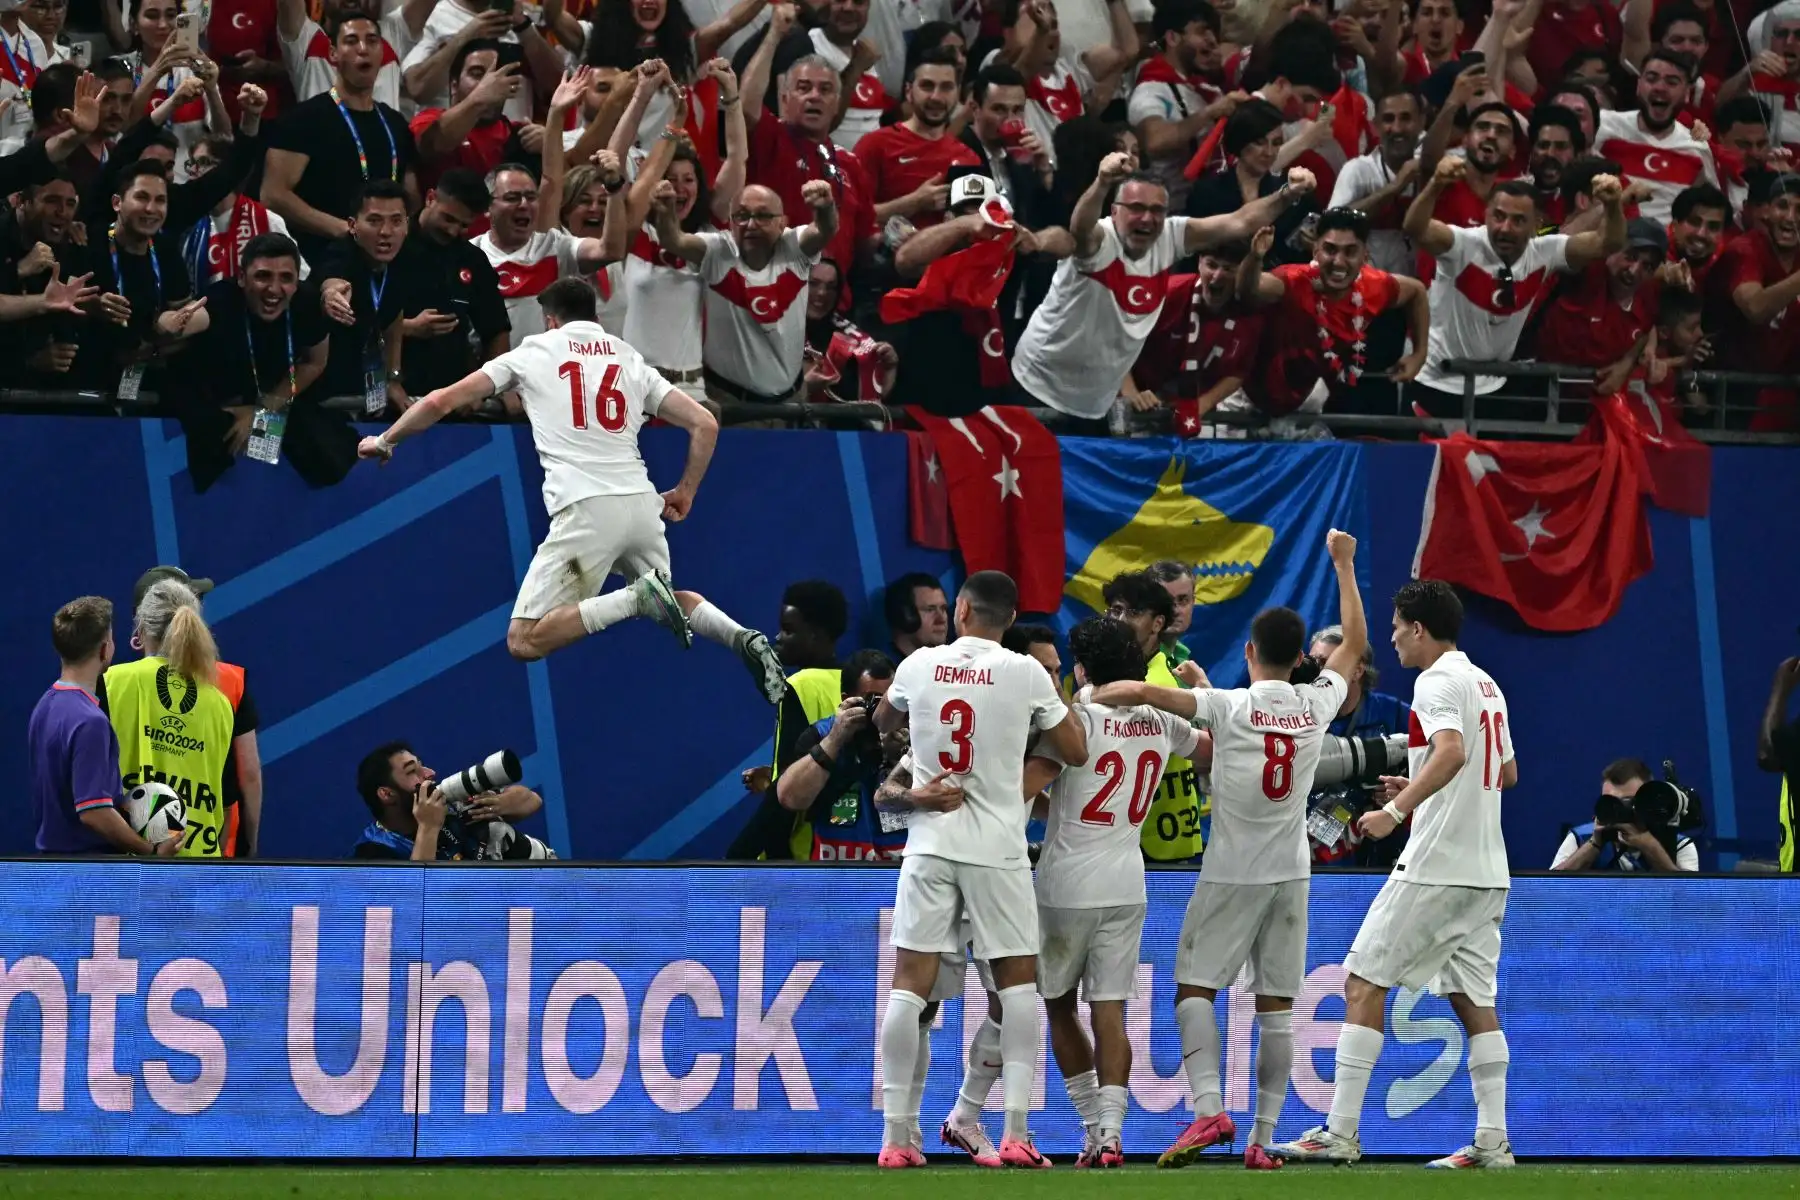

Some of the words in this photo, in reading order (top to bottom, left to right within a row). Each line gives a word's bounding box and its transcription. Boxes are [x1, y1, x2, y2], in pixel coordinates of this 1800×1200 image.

[558, 360, 628, 434] 16
[934, 665, 995, 686] DEMİRAL
[160, 718, 185, 732] UEFA
[938, 698, 976, 776] 3
[1080, 749, 1163, 828] 20
[1262, 731, 1299, 803] 8
[0, 914, 229, 1115] nts
[287, 905, 825, 1116] Unlock
